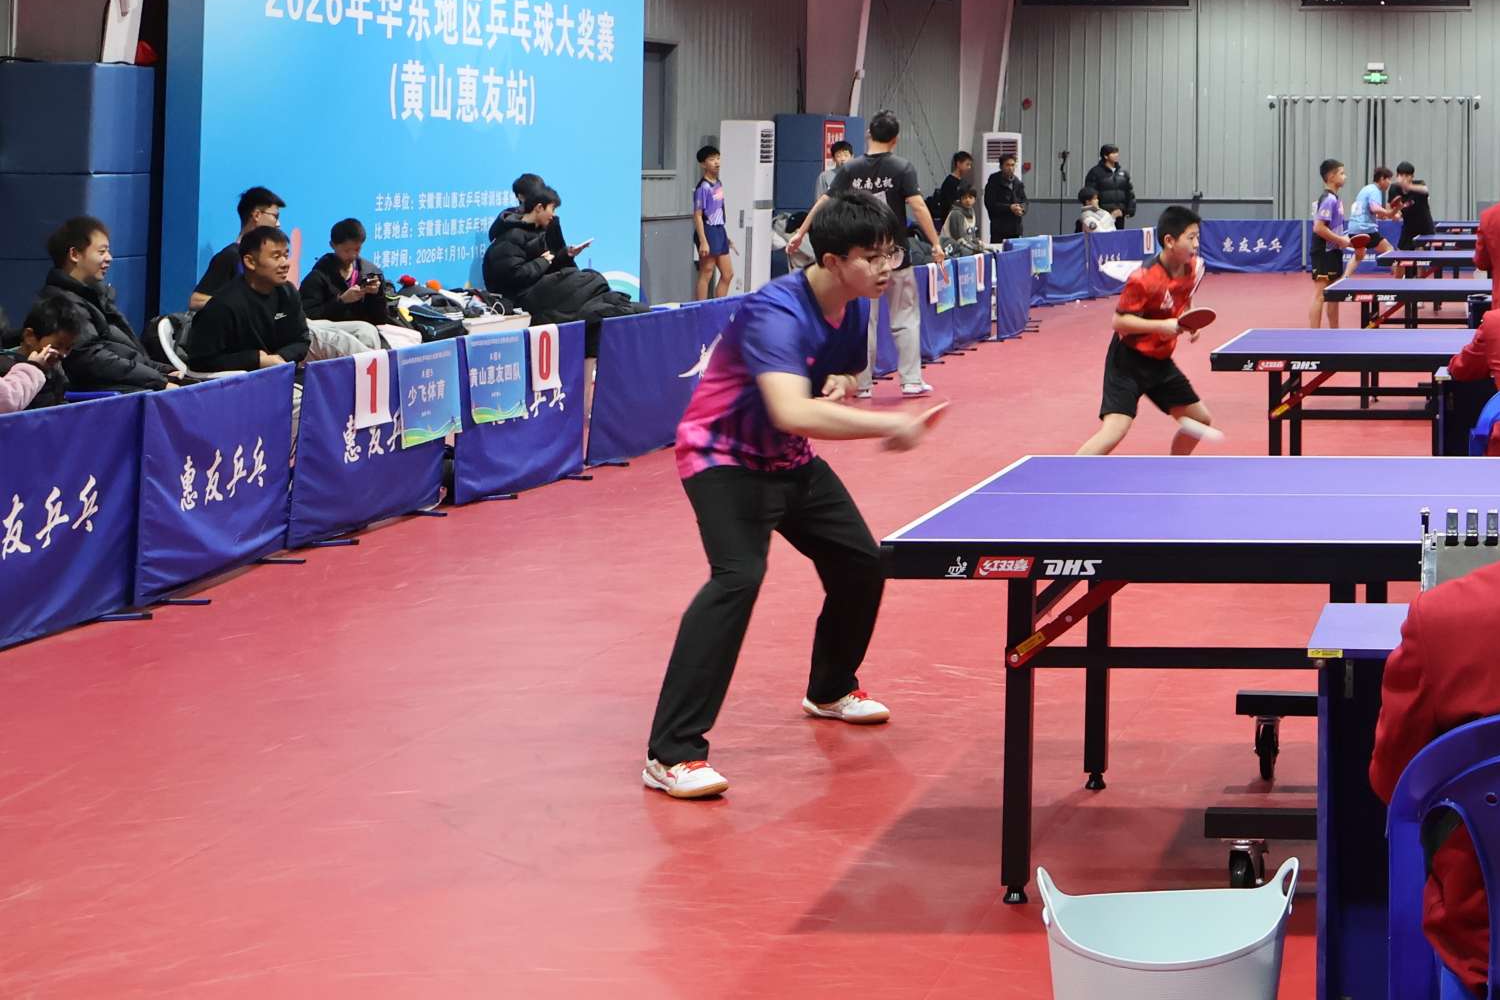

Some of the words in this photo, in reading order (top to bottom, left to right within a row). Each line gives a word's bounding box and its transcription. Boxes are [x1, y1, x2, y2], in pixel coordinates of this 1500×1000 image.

[389, 60, 536, 125] (黄山惠友站)
[538, 330, 551, 381] 0
[1290, 361, 1320, 370] DHS
[366, 358, 378, 414] 1
[180, 436, 267, 511] 惠友乒乓
[1043, 560, 1102, 576] DHS
